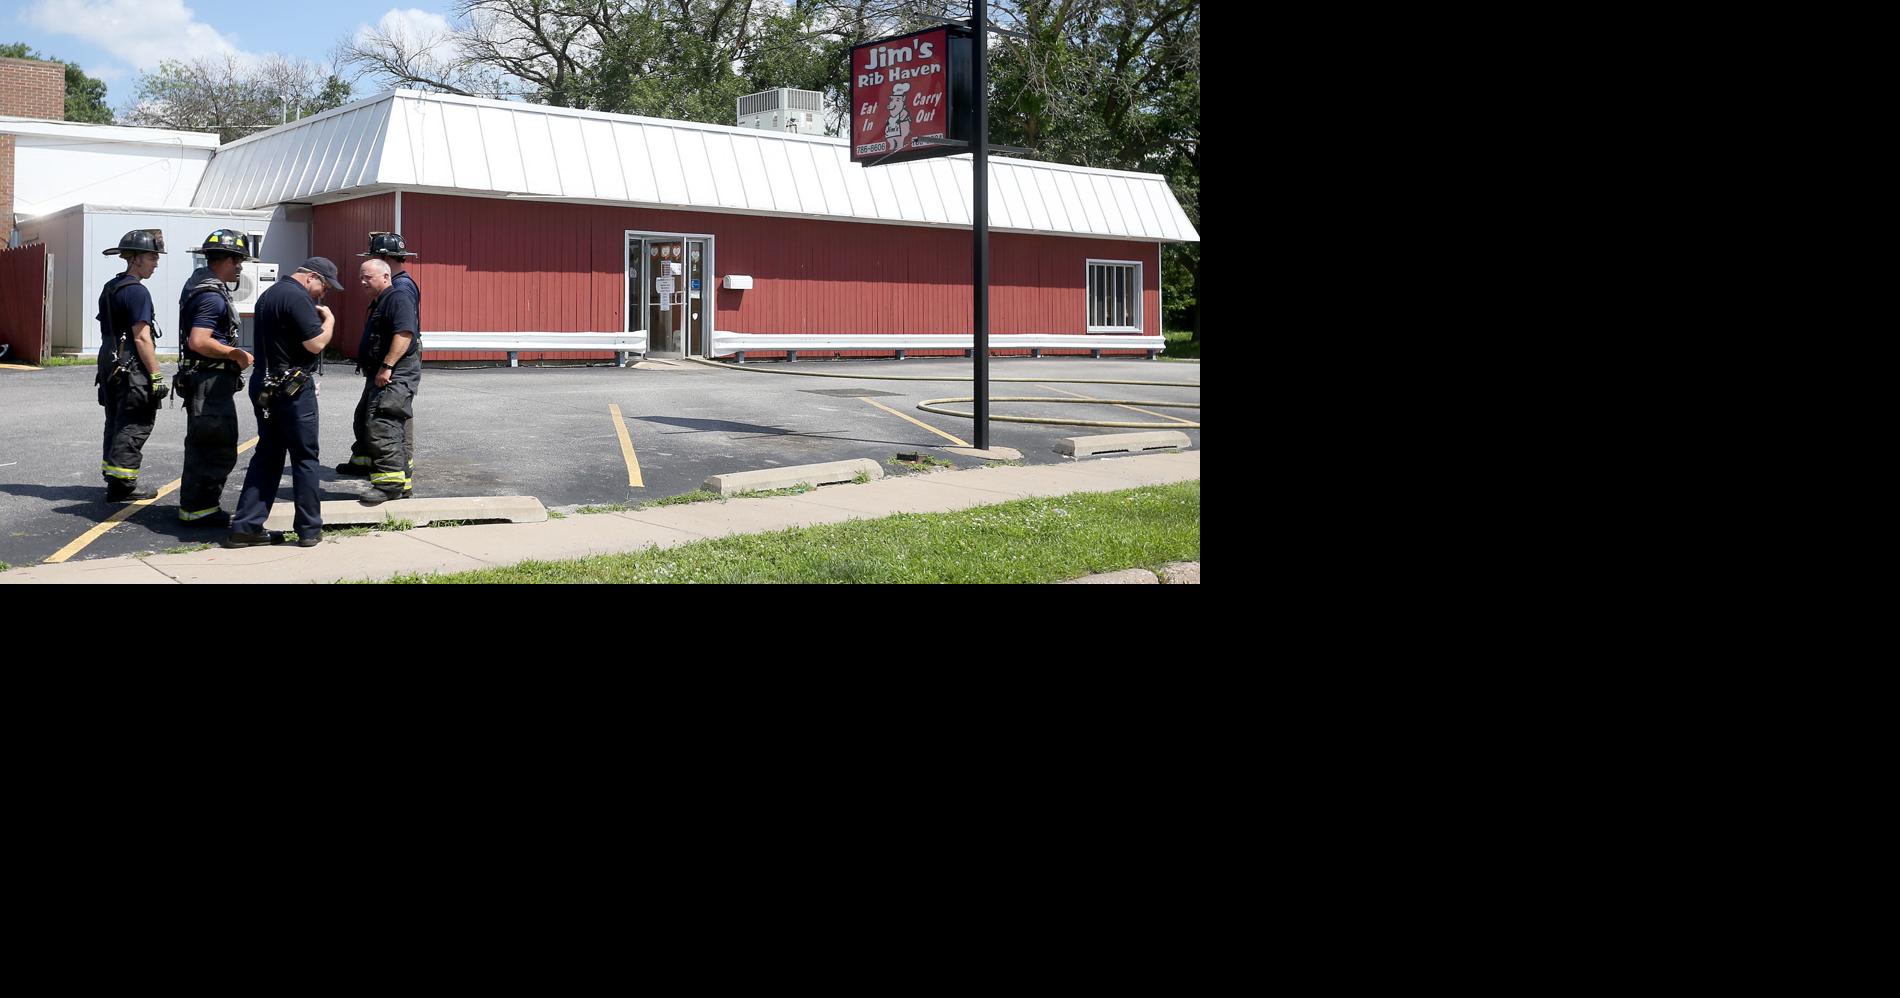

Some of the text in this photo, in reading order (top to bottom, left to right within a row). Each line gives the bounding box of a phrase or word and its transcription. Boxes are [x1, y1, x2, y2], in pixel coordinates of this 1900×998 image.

[865, 38, 934, 70] Jim's
[858, 63, 941, 88] Rib Haven
[912, 91, 942, 108] Carry
[860, 102, 878, 116] Eat
[915, 108, 936, 123] Out
[862, 118, 874, 132] In
